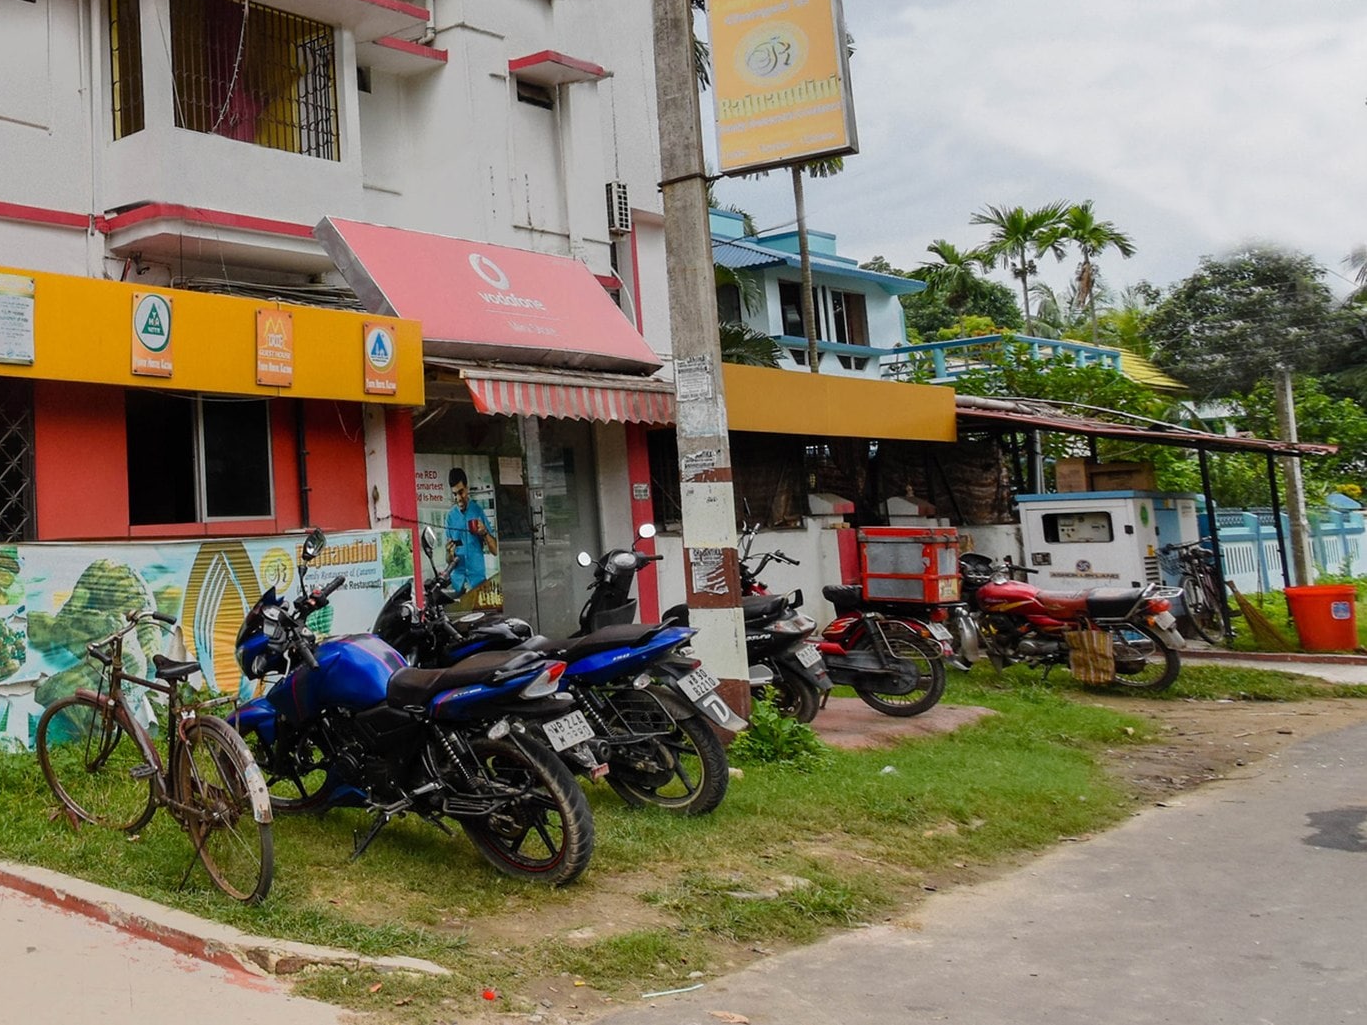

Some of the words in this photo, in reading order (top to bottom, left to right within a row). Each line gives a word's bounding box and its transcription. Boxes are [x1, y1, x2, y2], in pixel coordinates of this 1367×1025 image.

[477, 291, 547, 312] vodafone
[424, 470, 438, 480] RED
[416, 483, 444, 491] smartest
[430, 493, 444, 502] here
[687, 674, 699, 686] WB
[702, 694, 730, 723] D
[550, 721, 566, 734] WB
